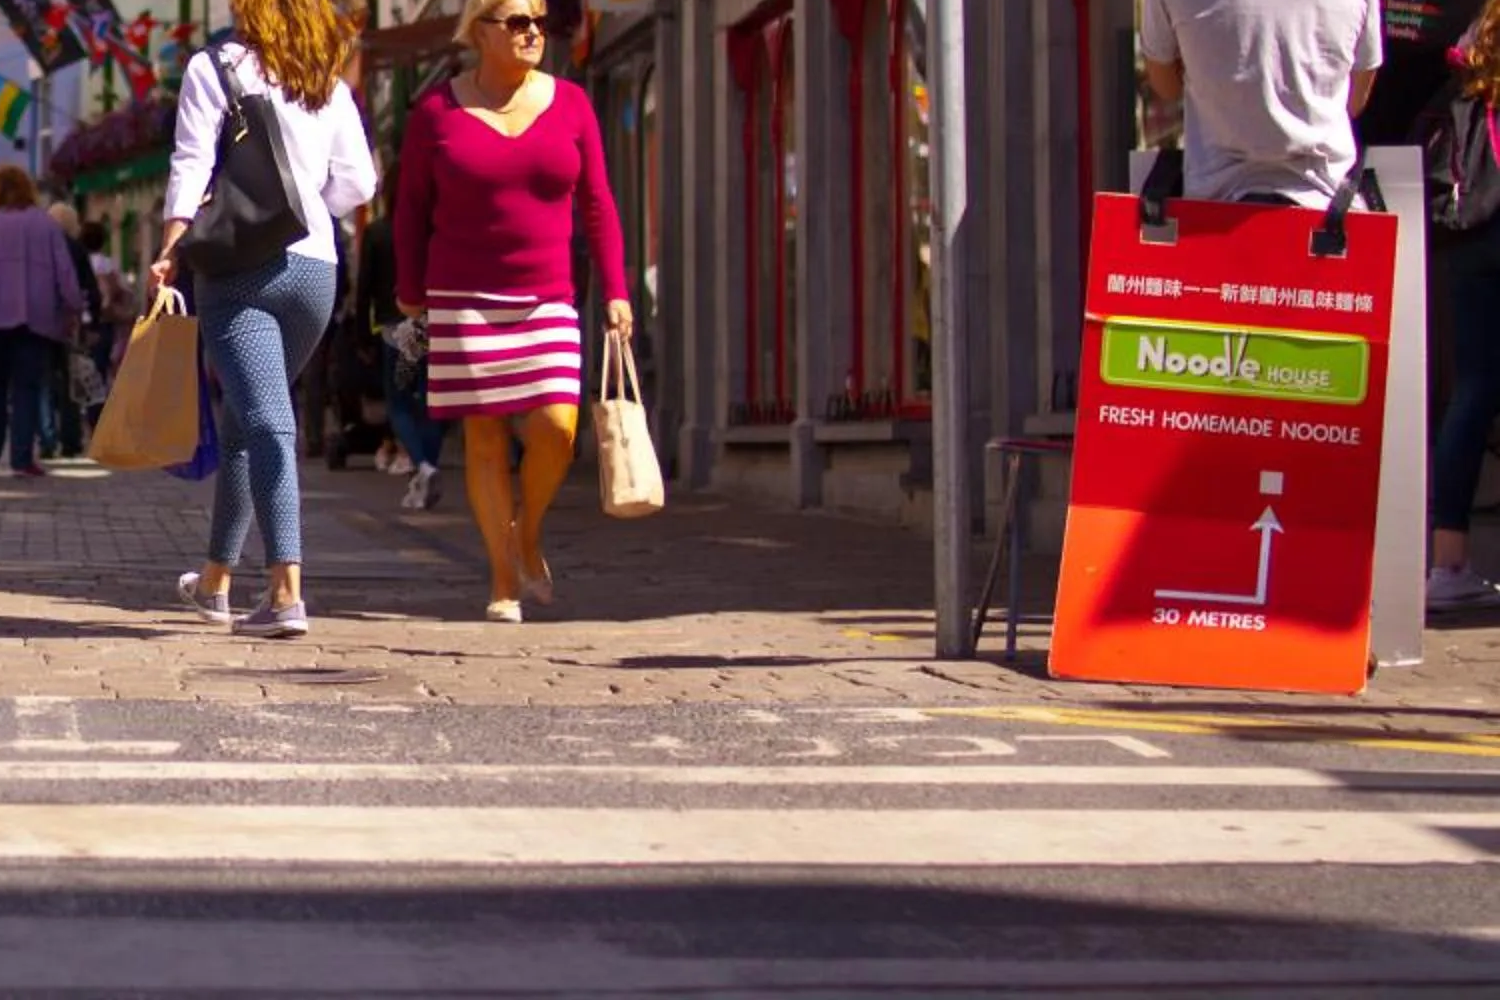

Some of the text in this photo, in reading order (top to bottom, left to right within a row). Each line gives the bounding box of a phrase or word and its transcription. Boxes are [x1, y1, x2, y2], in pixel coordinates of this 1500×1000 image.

[1136, 331, 1331, 387] Noodle HOUSE
[1099, 405, 1361, 445] FRESH HOMEMADE NOODLE
[1152, 606, 1266, 631] 30 METRES
